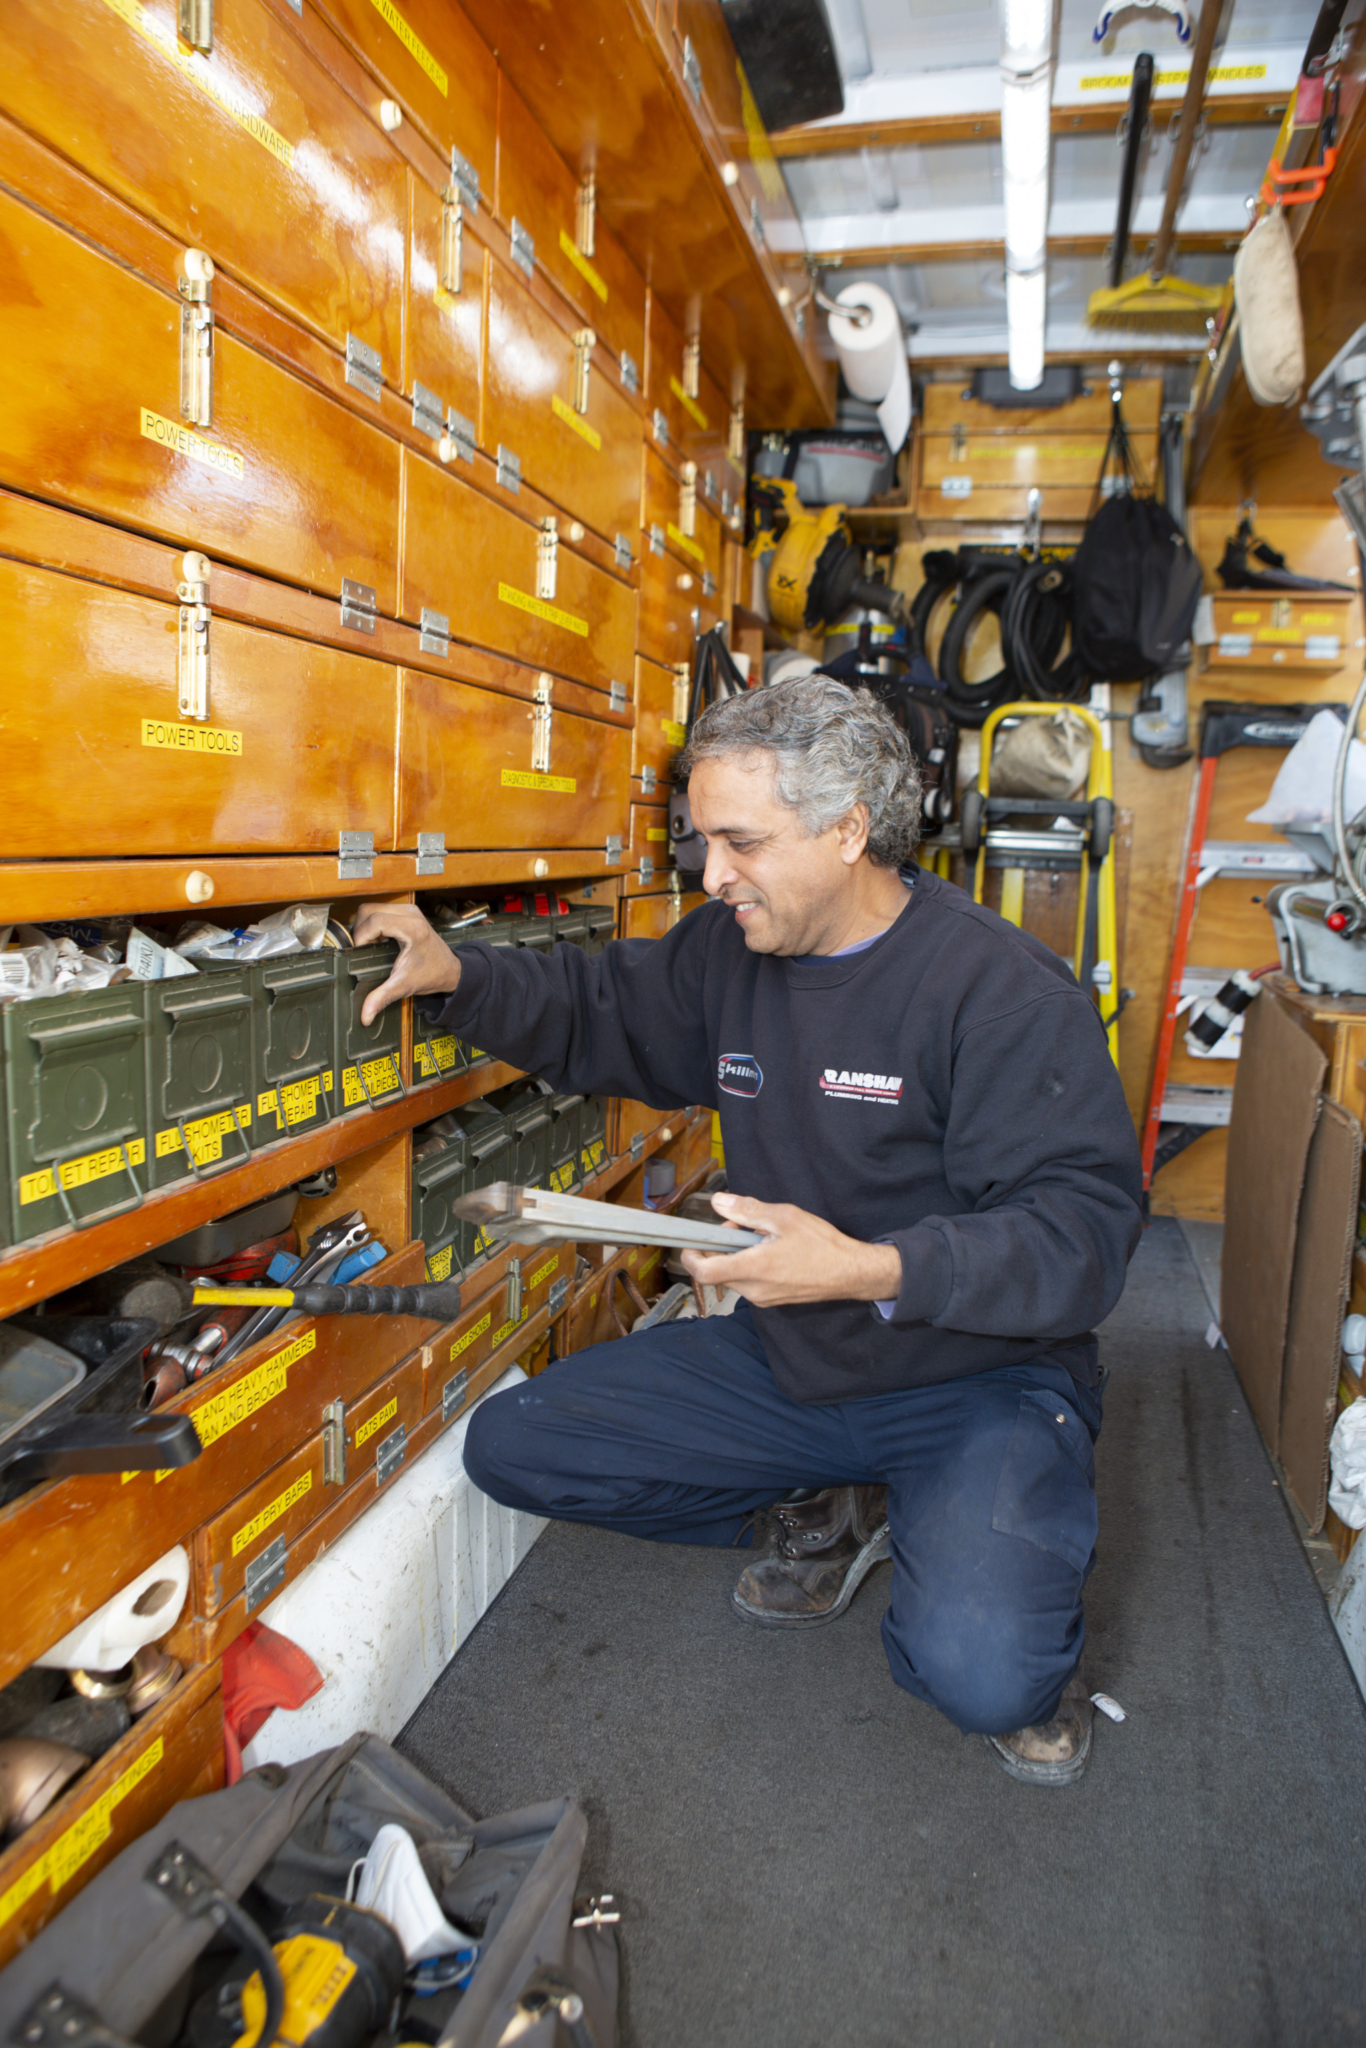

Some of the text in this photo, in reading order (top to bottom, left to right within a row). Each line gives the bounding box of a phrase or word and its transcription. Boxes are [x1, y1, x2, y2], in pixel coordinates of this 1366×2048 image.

[382, 0, 410, 46] WATER
[1082, 78, 1128, 90] BROOM
[224, 97, 290, 164] HARDWARE
[146, 414, 240, 475] POWER TOOLS
[146, 724, 240, 752] POWER TOOLS
[502, 771, 532, 787] DIAGNOSTIC
[537, 776, 560, 790] SPECIALTY
[561, 779, 575, 791] TOOLS
[431, 1036, 455, 1055] STRAPS
[347, 1073, 397, 1103] VB TAILPIECE
[825, 1090, 862, 1100] PLUMBING
[877, 1097, 899, 1105] HEATING
[192, 1141, 220, 1163] KITS
[26, 1162, 83, 1198] TOIET
[430, 1247, 450, 1271] BRASS
[452, 1316, 490, 1359] SOOT SHOVEL
[494, 1326, 506, 1345] SLAP
[202, 1395, 225, 1424] AND
[229, 1370, 263, 1406] HEAVY
[266, 1333, 313, 1378] HAMMERS
[222, 1404, 244, 1432] AND
[247, 1376, 284, 1414] BROOM
[358, 1400, 396, 1444] CATS PAW
[235, 1475, 309, 1551] FLAT PRY BARS
[100, 1742, 160, 1812] FITTINGS
[58, 1822, 106, 1882] TRAPS
